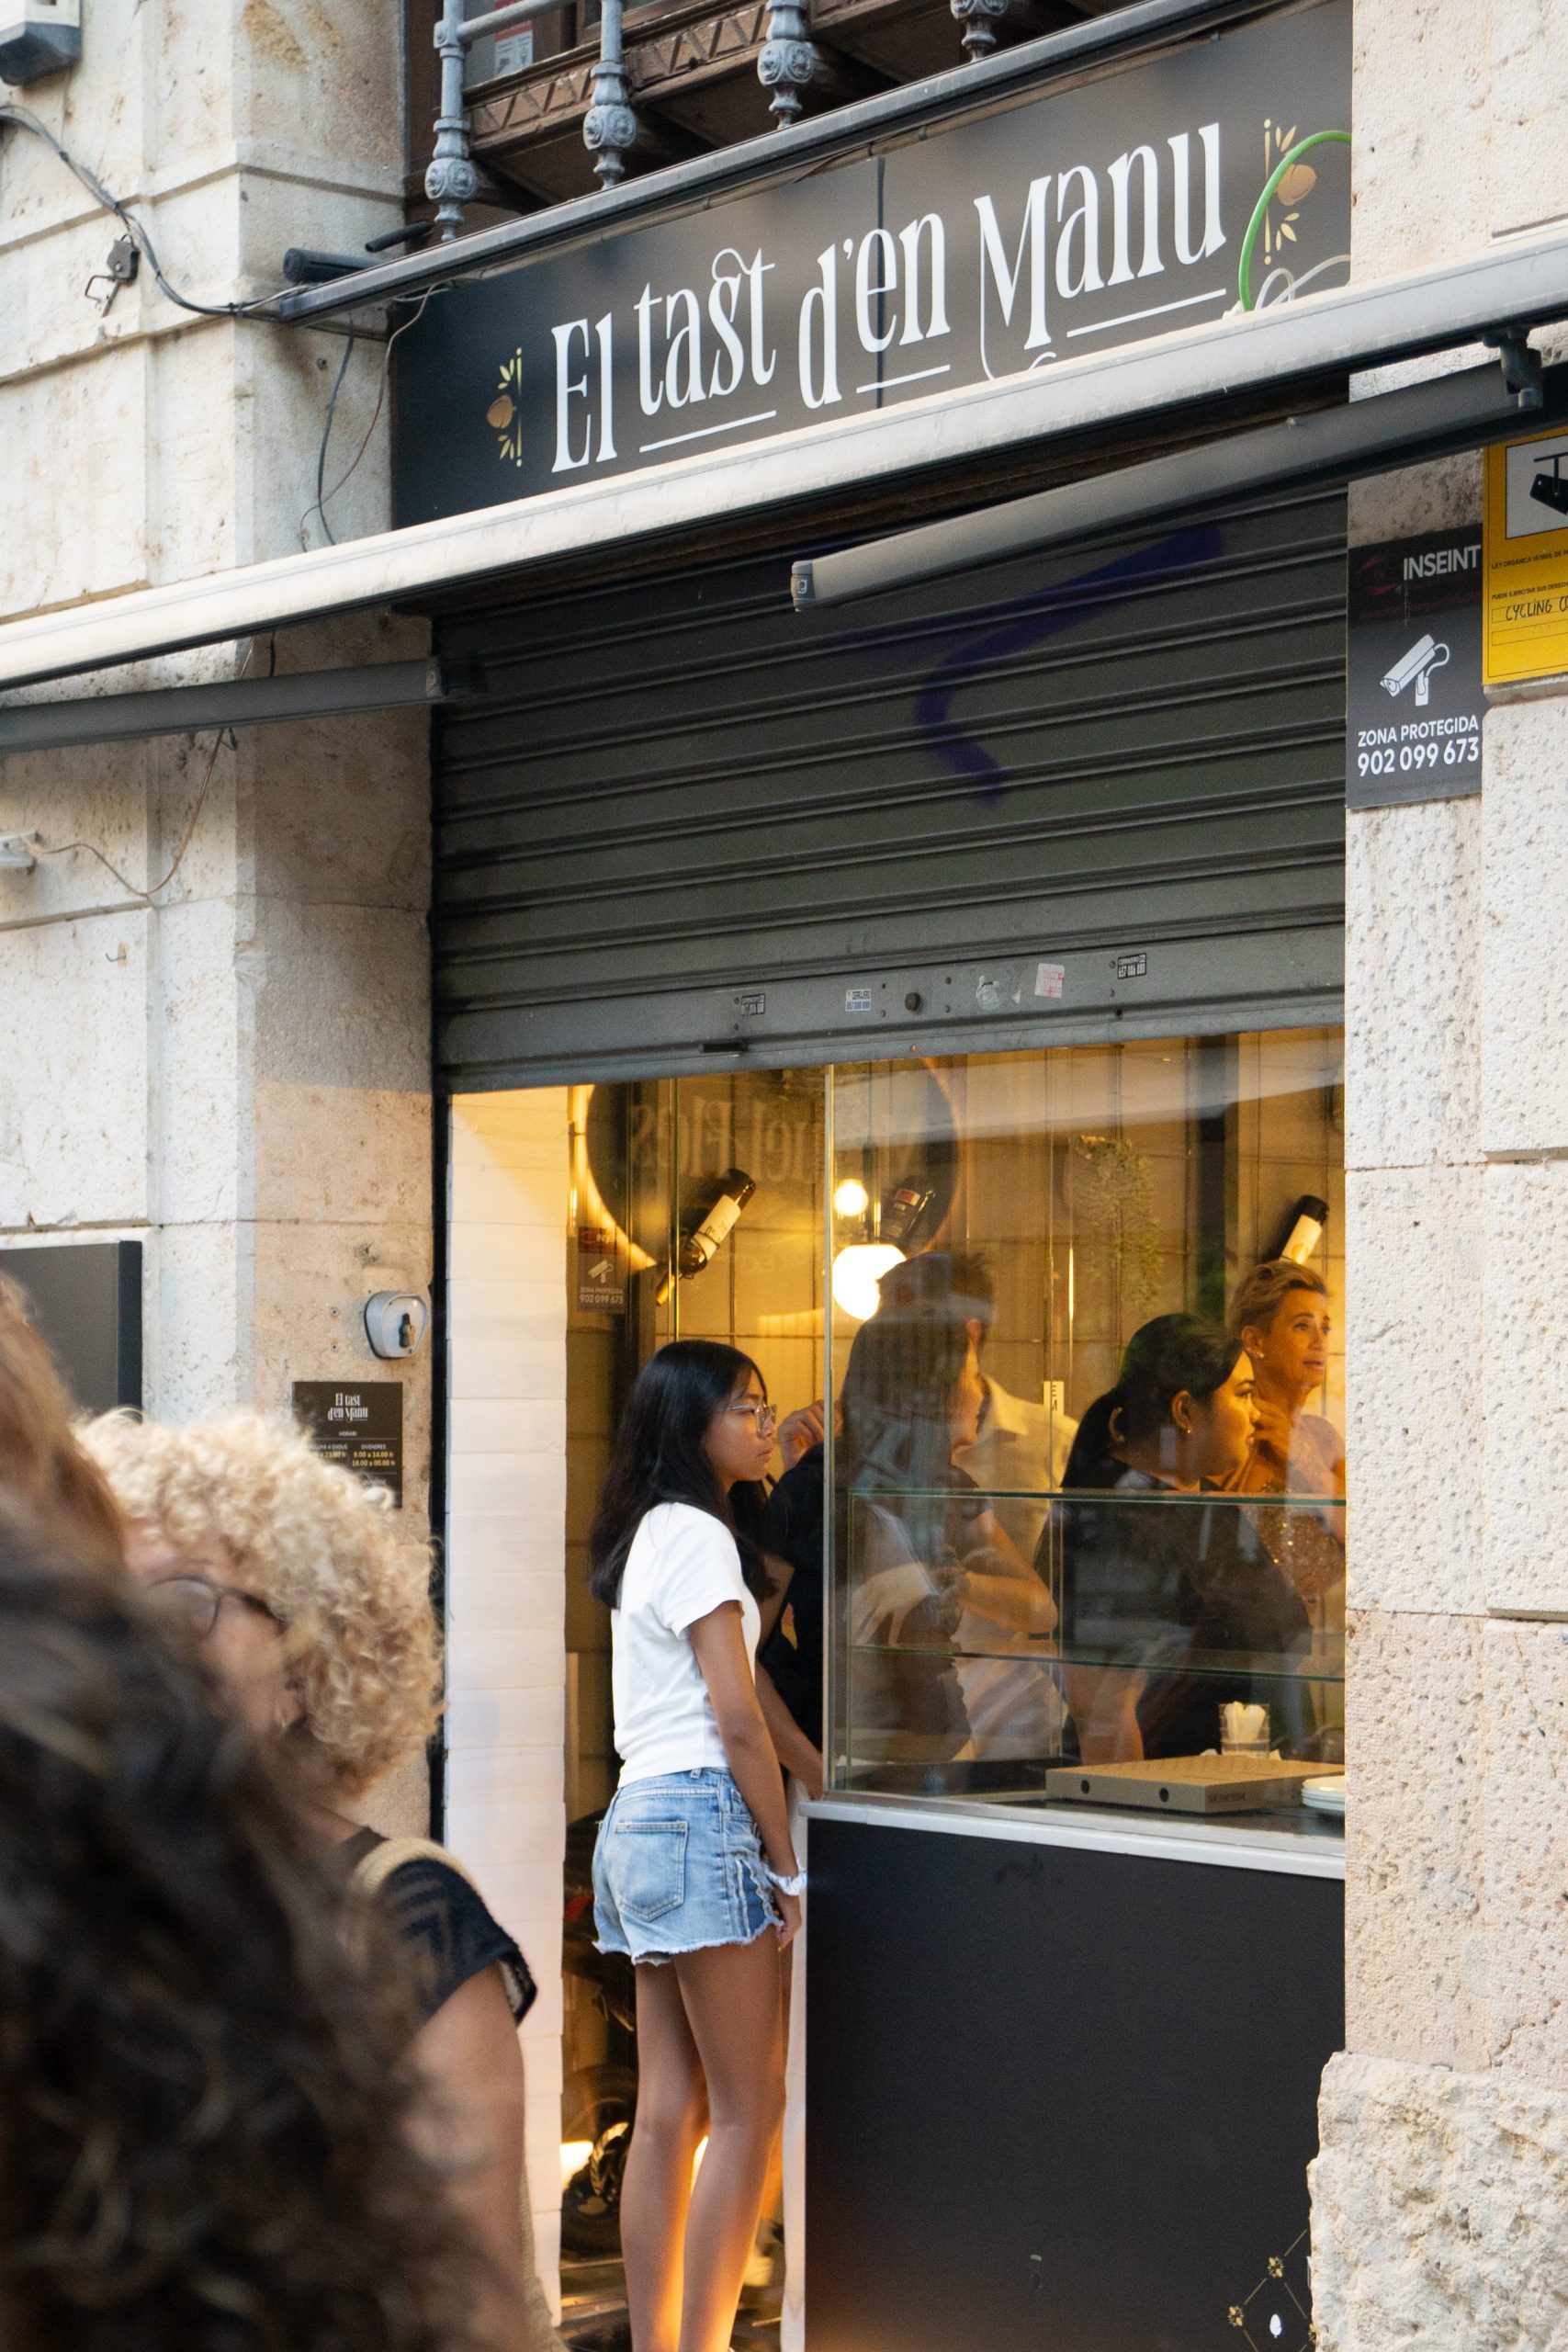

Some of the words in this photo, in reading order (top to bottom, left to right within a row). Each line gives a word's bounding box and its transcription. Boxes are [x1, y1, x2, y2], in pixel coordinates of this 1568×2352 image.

[551, 313, 616, 472] El
[634, 248, 775, 416] tast
[799, 213, 950, 408] d'en
[974, 122, 1225, 379] Manu
[1404, 545, 1482, 581] INSEINT
[1358, 725, 1397, 748] ZONA
[1401, 715, 1479, 741] PROTEGIDA
[1358, 749, 1394, 777] 902
[1399, 743, 1438, 771] 099
[1443, 737, 1480, 765] 673
[580, 1293, 594, 1303] 902
[594, 1294, 610, 1304] 099
[610, 1295, 624, 1305] 673
[335, 1393, 344, 1407] El
[345, 1395, 361, 1407] tast
